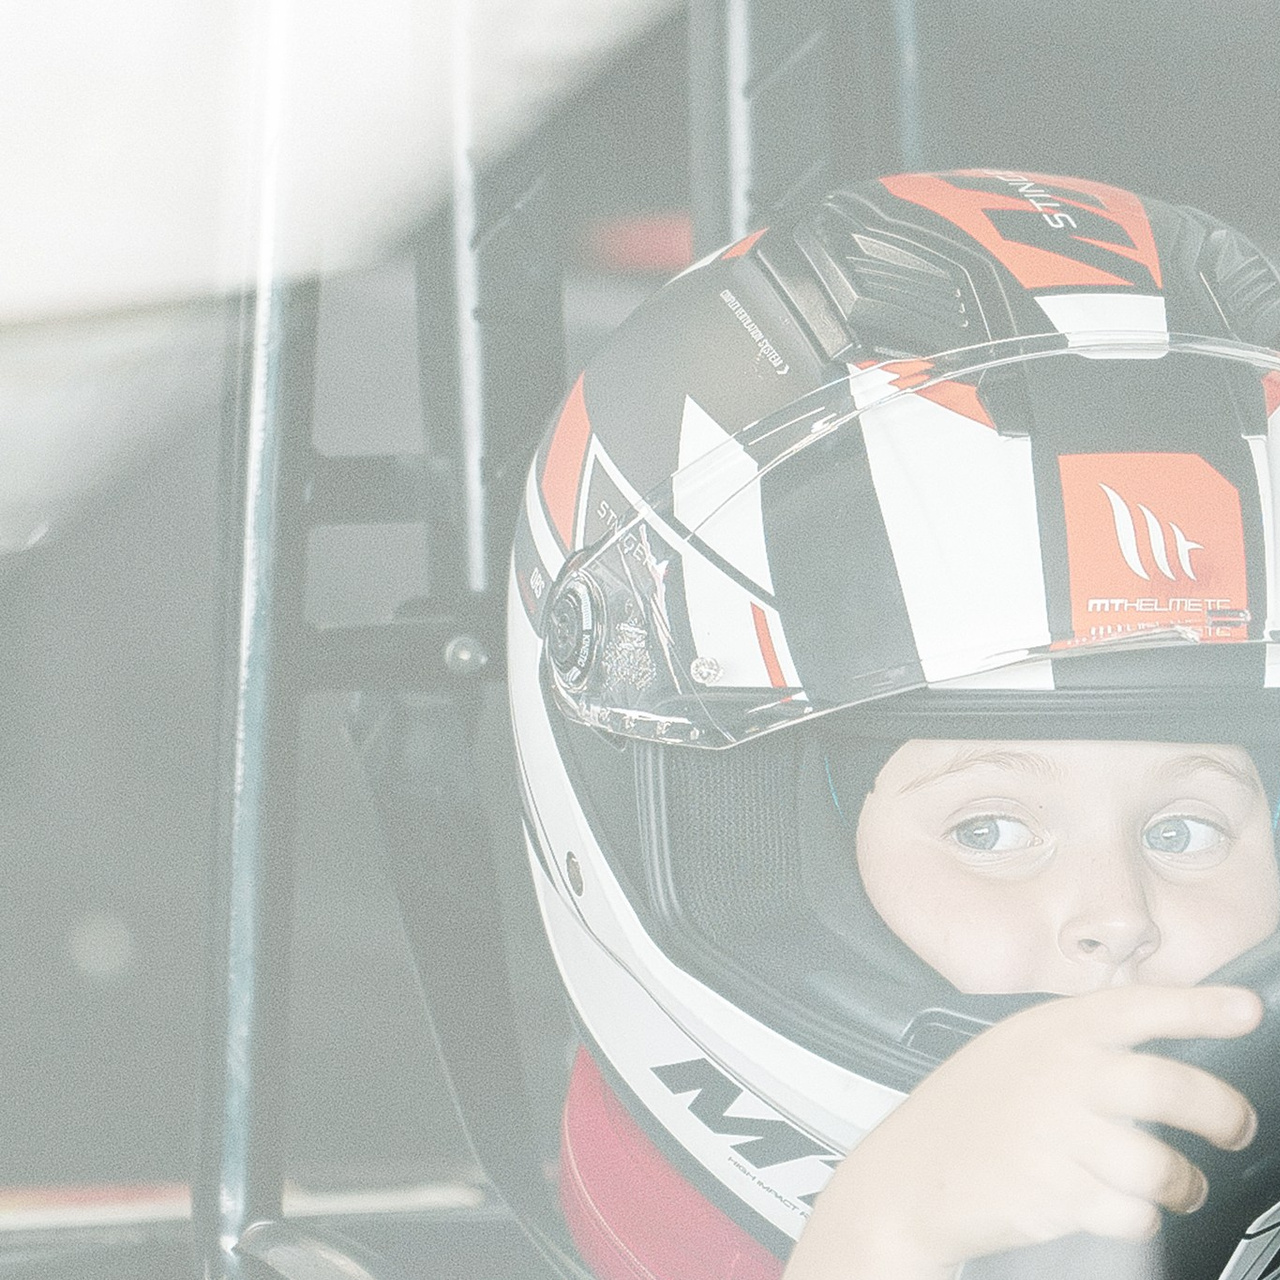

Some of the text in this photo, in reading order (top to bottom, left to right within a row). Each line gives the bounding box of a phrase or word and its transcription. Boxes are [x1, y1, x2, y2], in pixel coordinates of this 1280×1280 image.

[757, 338, 784, 368] SYSTEM
[578, 634, 591, 667] KINETIC
[727, 1156, 801, 1213] HIGH IMPACT
